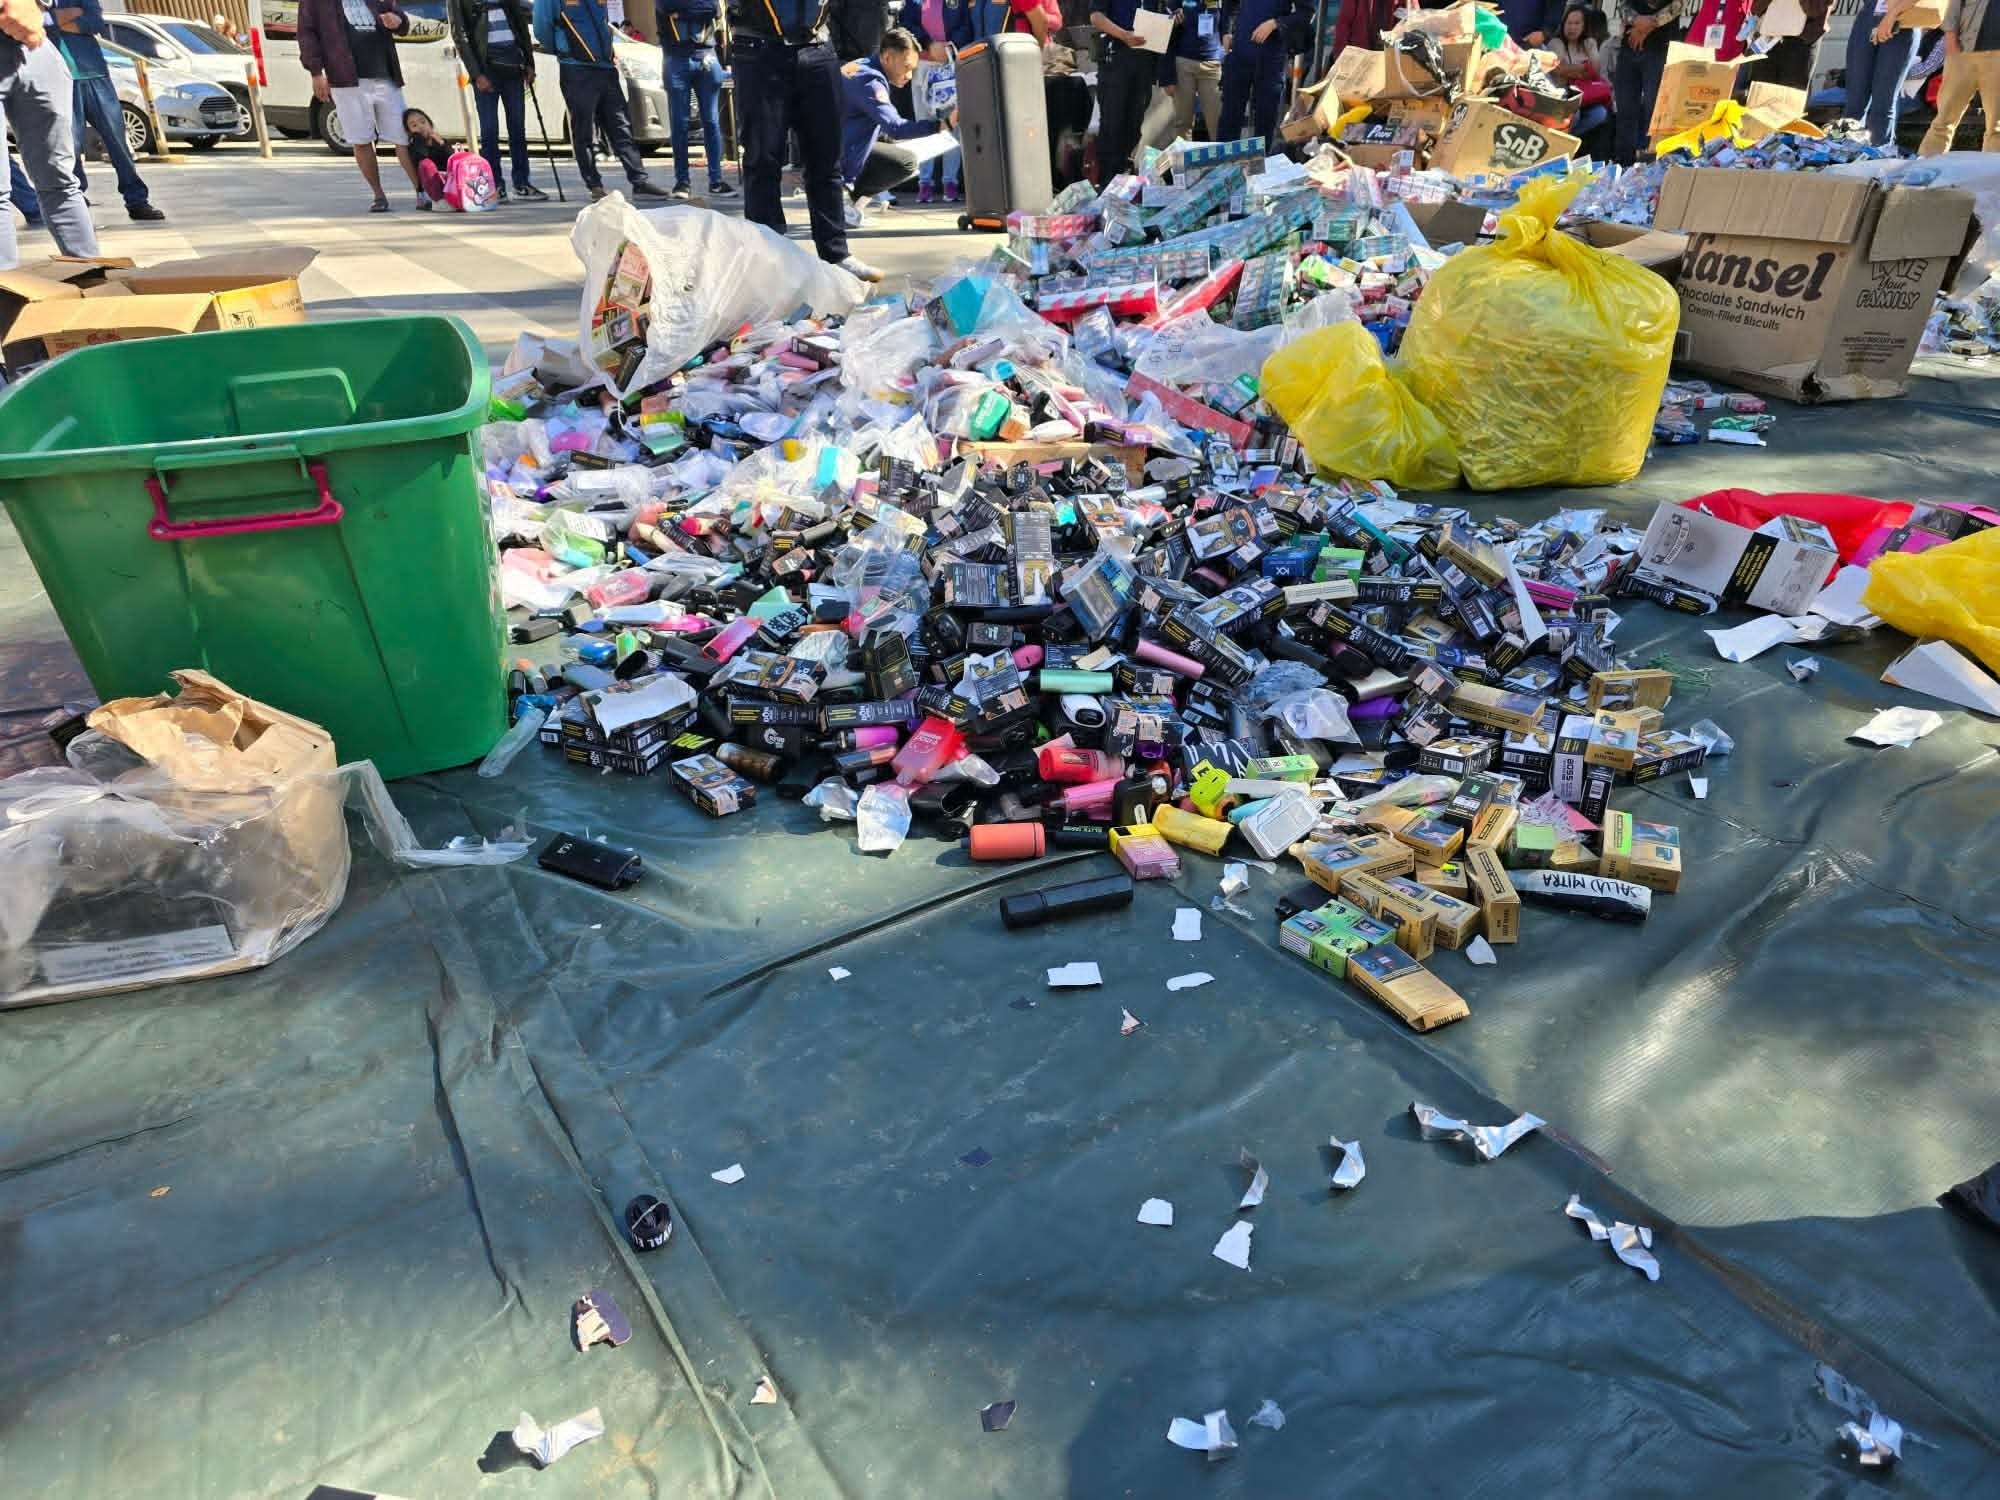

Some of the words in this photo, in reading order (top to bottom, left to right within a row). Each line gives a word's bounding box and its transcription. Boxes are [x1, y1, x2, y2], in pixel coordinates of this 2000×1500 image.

[1495, 126, 1545, 160] SnB
[1680, 233, 1836, 301] Hansel
[1677, 283, 1733, 307] Chocolate
[1735, 296, 1805, 321] Sandwich
[1856, 289, 1920, 310] FAMILY
[1688, 303, 1741, 323] Cream-Filled
[1743, 315, 1780, 331] Biscuits
[1542, 873, 1586, 889] MITRA
